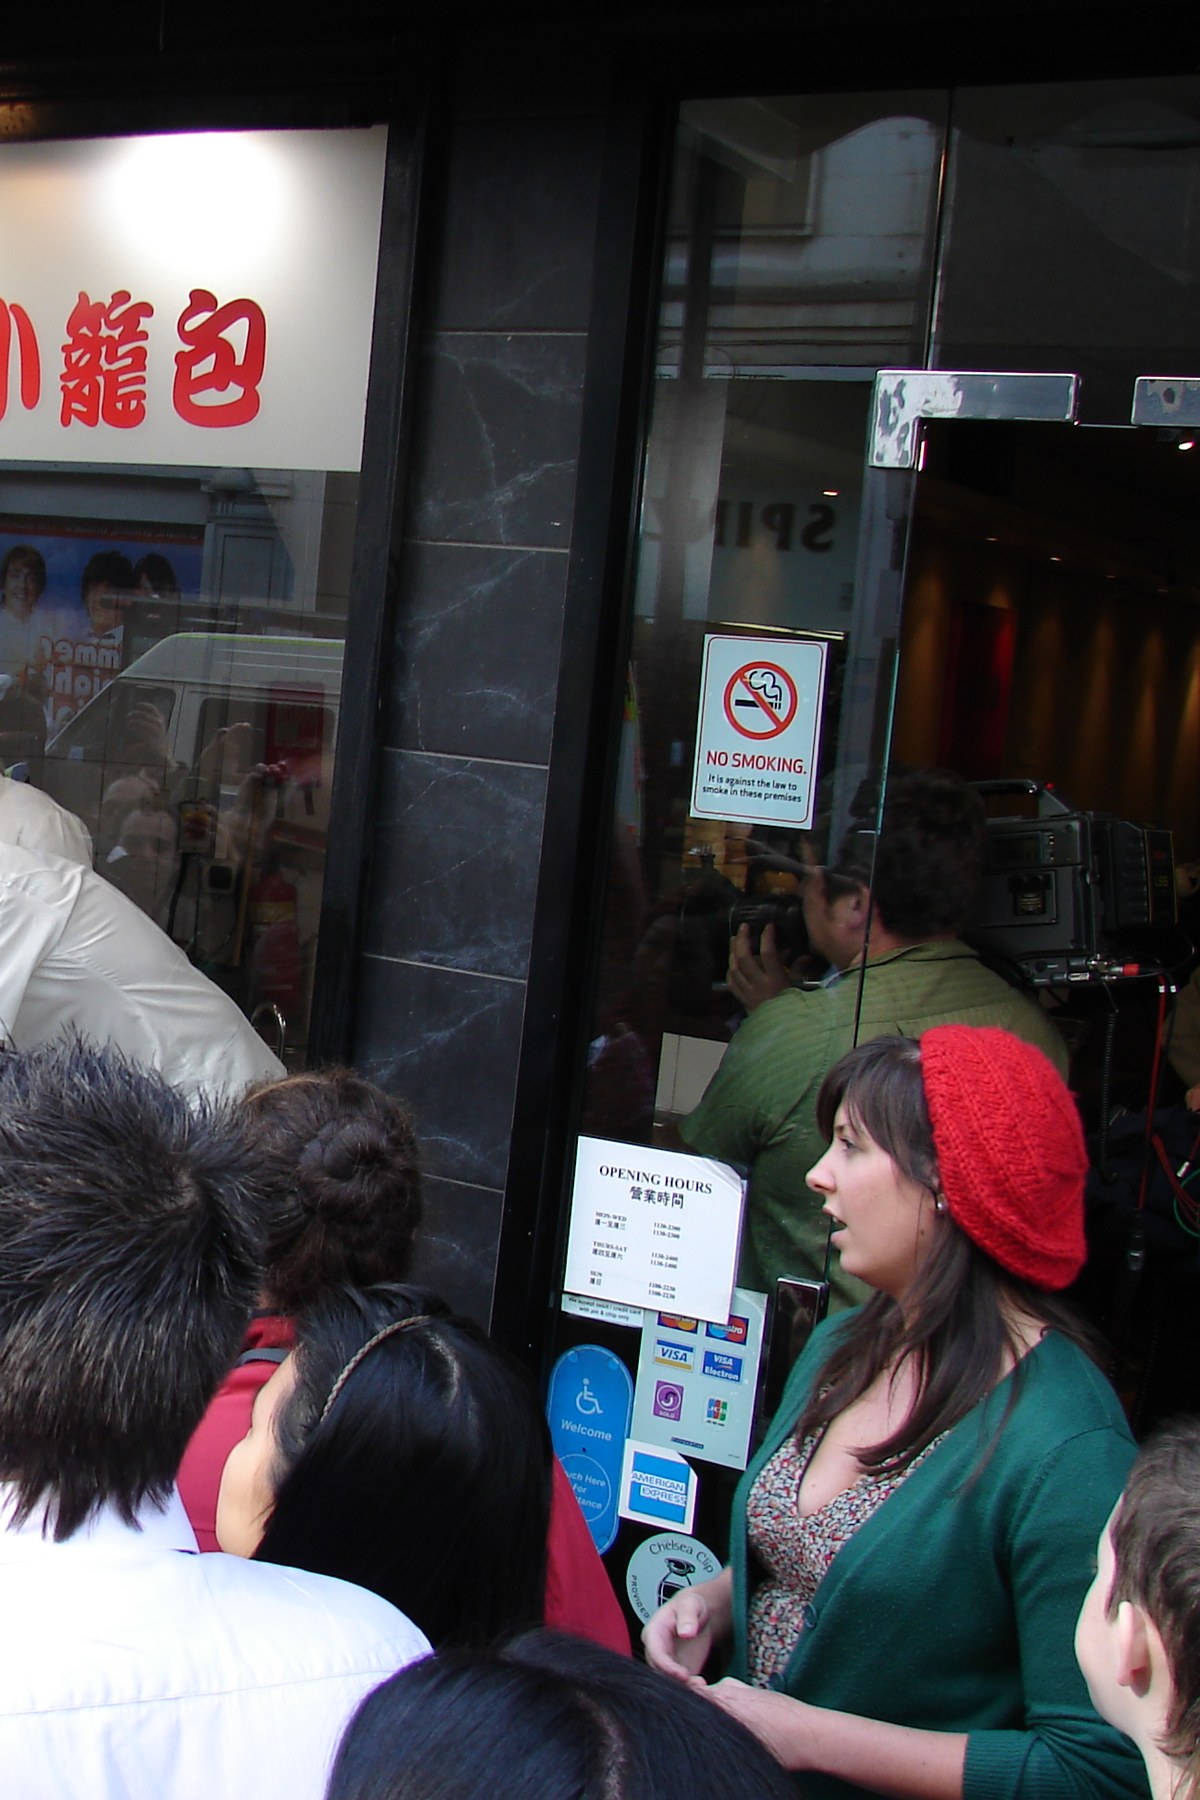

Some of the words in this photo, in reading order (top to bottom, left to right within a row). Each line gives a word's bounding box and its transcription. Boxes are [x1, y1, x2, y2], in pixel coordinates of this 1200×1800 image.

[706, 750, 729, 767] NO
[731, 752, 807, 776] SMOKING.
[708, 773, 715, 783] It
[716, 774, 724, 784] is
[725, 777, 755, 788] against
[756, 779, 771, 789] the
[772, 780, 786, 791] law
[788, 782, 798, 792] to
[702, 785, 729, 796] smoke
[730, 786, 738, 797] in
[740, 788, 763, 799] these
[764, 791, 802, 803] premises
[599, 1165, 661, 1186] OPENING
[664, 1175, 713, 1194] HOURS
[629, 1186, 684, 1209] 營業時間
[661, 1347, 688, 1363] VISA
[713, 1354, 733, 1366] VISA
[704, 1365, 739, 1381] Electron
[561, 1419, 612, 1442] Welcome
[573, 1483, 587, 1494] For
[584, 1474, 606, 1487] Here
[632, 1471, 684, 1492] AMERICAN
[642, 1487, 687, 1505] EXPRESS
[649, 1540, 693, 1556] Chelsea
[696, 1551, 714, 1574] Clip
